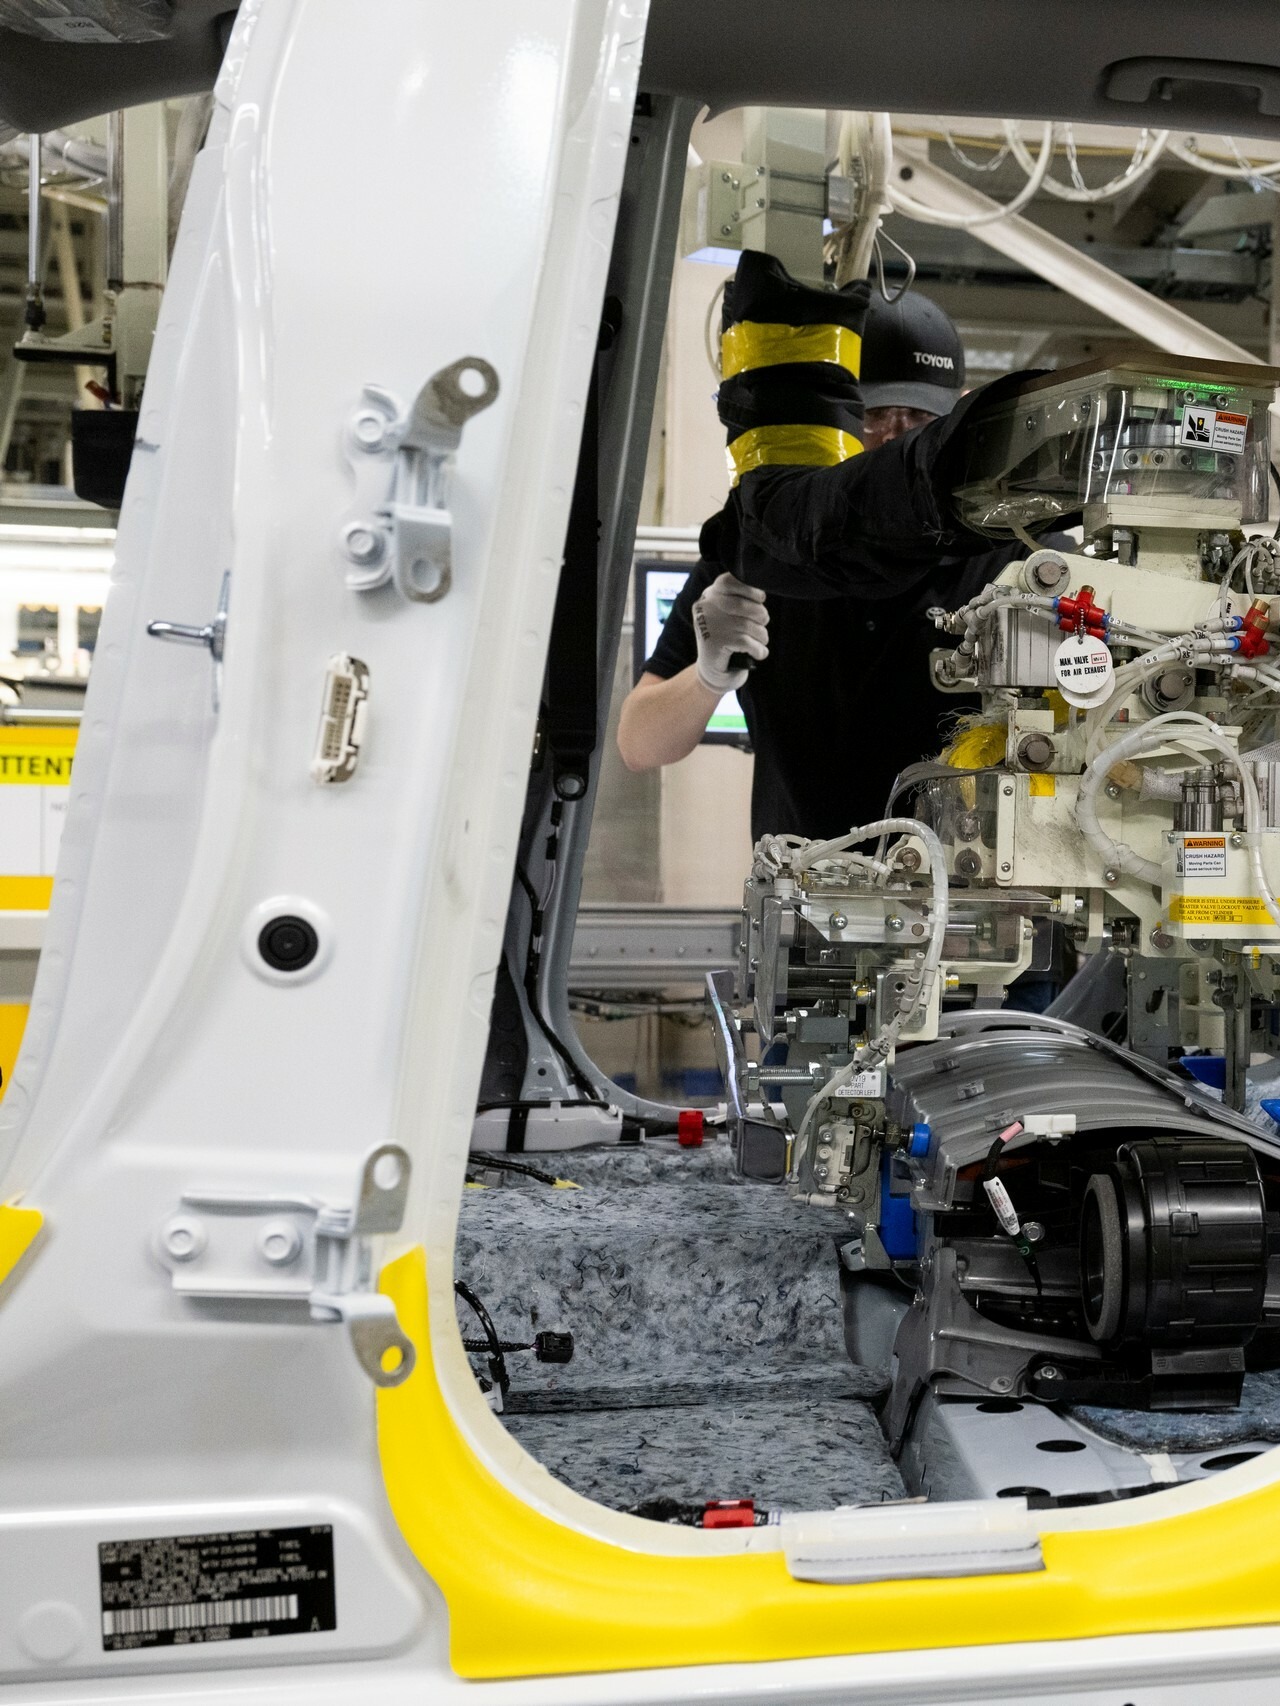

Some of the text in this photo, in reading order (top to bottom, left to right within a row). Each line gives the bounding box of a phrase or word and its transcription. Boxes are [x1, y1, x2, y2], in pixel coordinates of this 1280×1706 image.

[913, 352, 954, 370] TOYOTA
[1224, 415, 1246, 424] WARNING
[1060, 657, 1073, 667] MAN.
[1074, 655, 1089, 665] VALVE
[1060, 666, 1107, 677] FOR AIR EXHAUST
